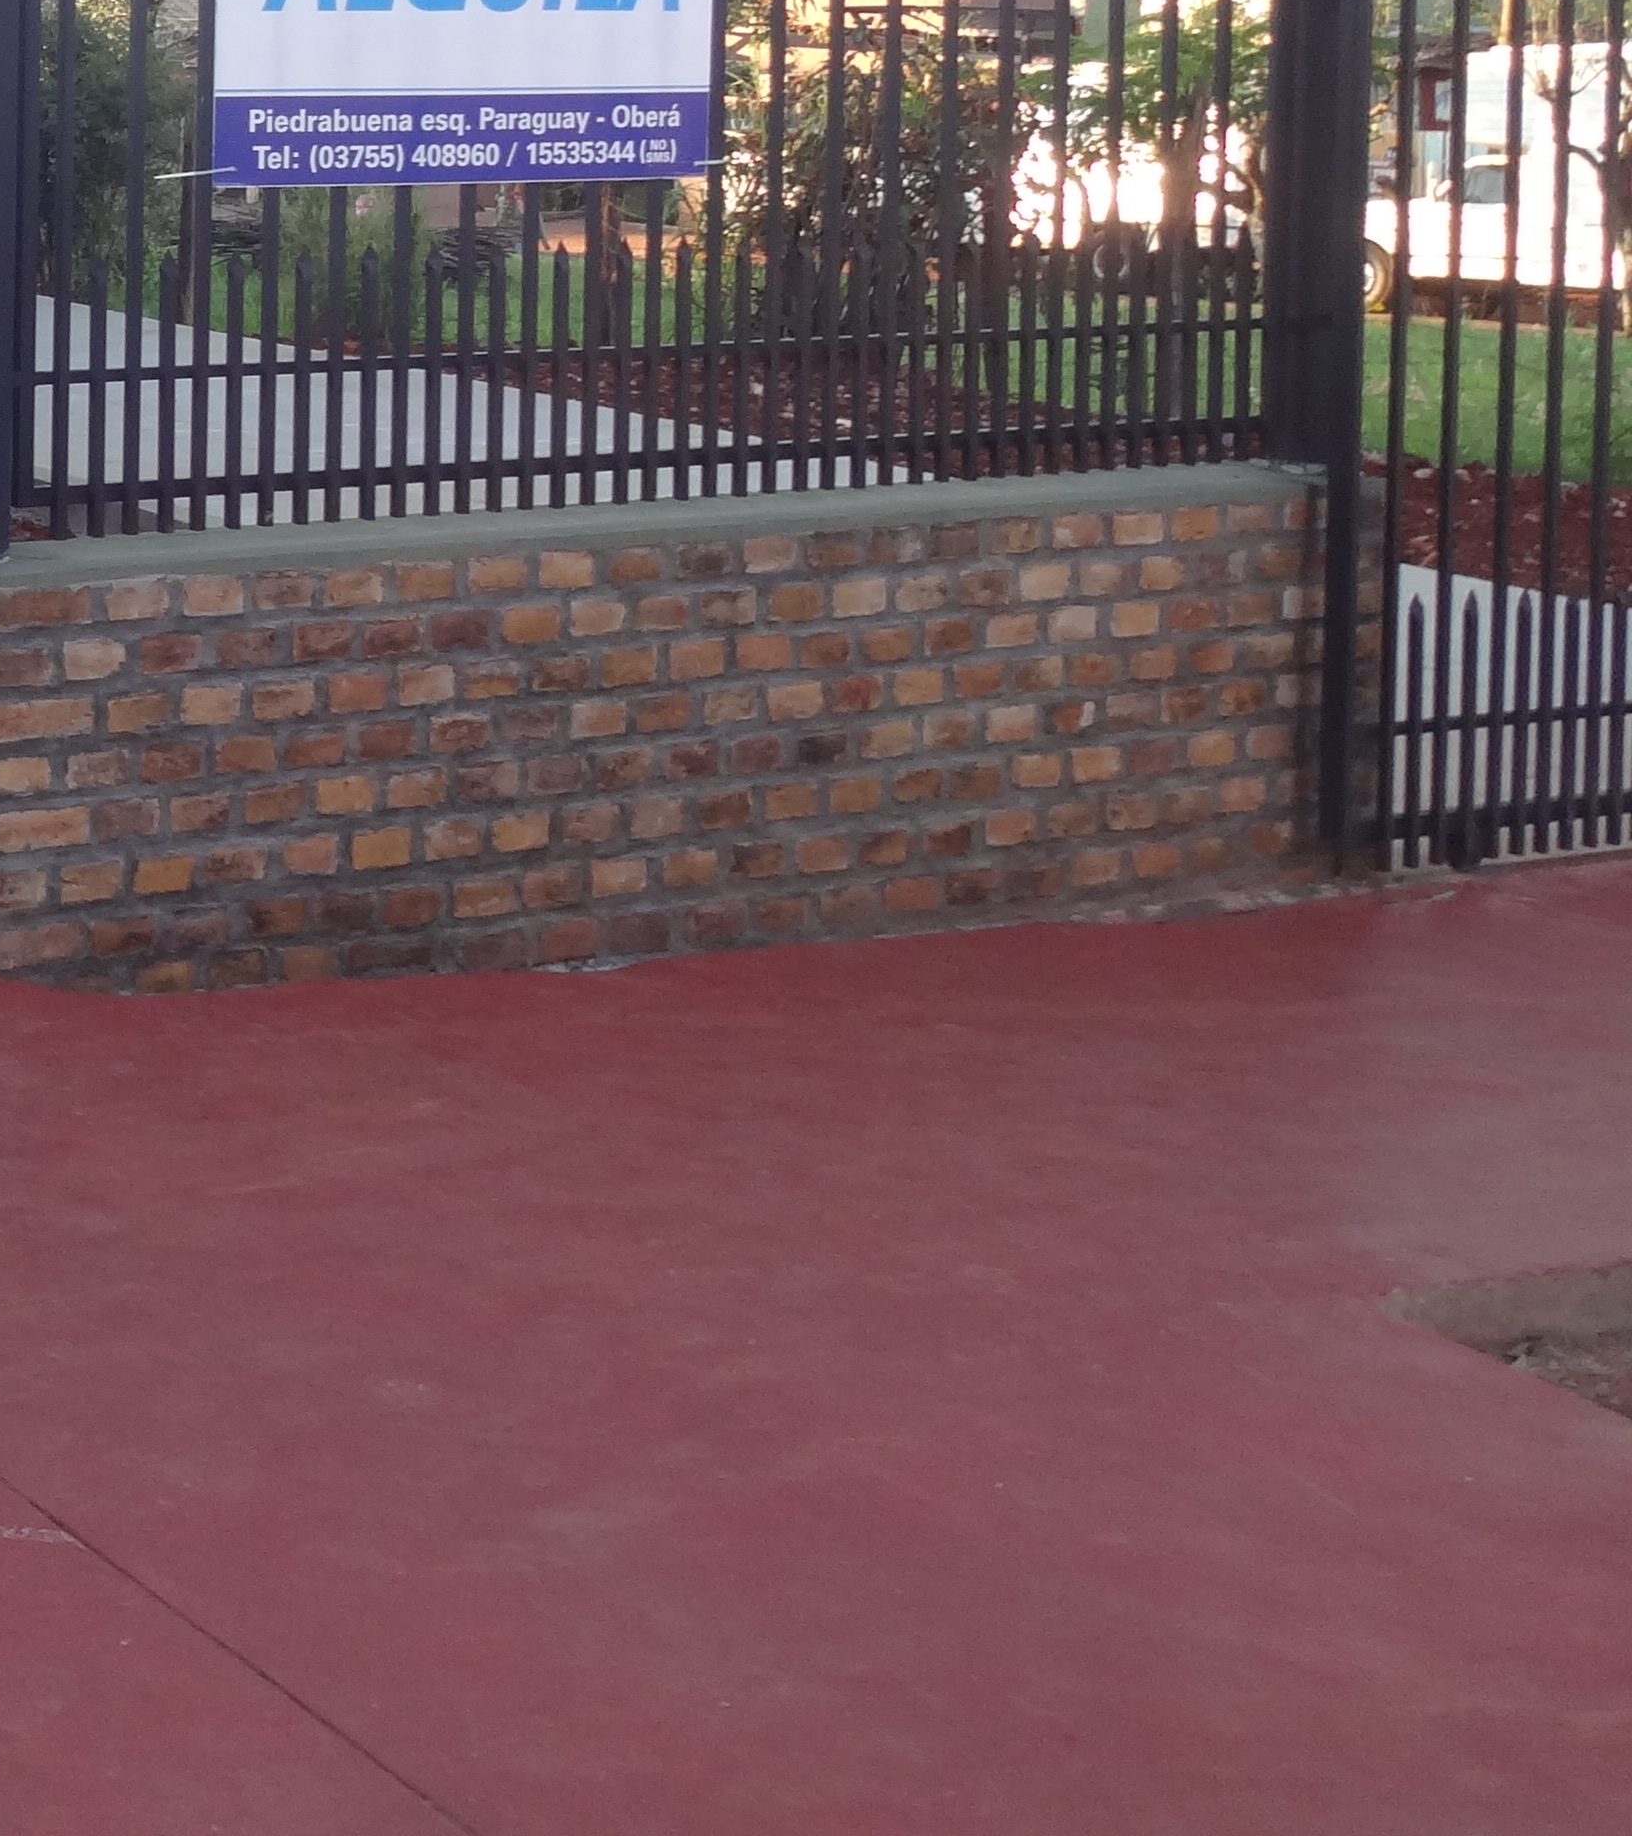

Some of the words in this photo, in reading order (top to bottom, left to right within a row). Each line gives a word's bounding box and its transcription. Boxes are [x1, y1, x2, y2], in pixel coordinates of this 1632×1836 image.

[248, 107, 413, 134] Piedrabuena
[420, 113, 472, 138] esq.
[479, 106, 590, 137] Paraguay
[611, 103, 681, 130] Oberá
[252, 145, 300, 170] Tel:
[309, 143, 405, 173] (03755)
[411, 142, 501, 168] 408960
[526, 139, 636, 165] 15535344
